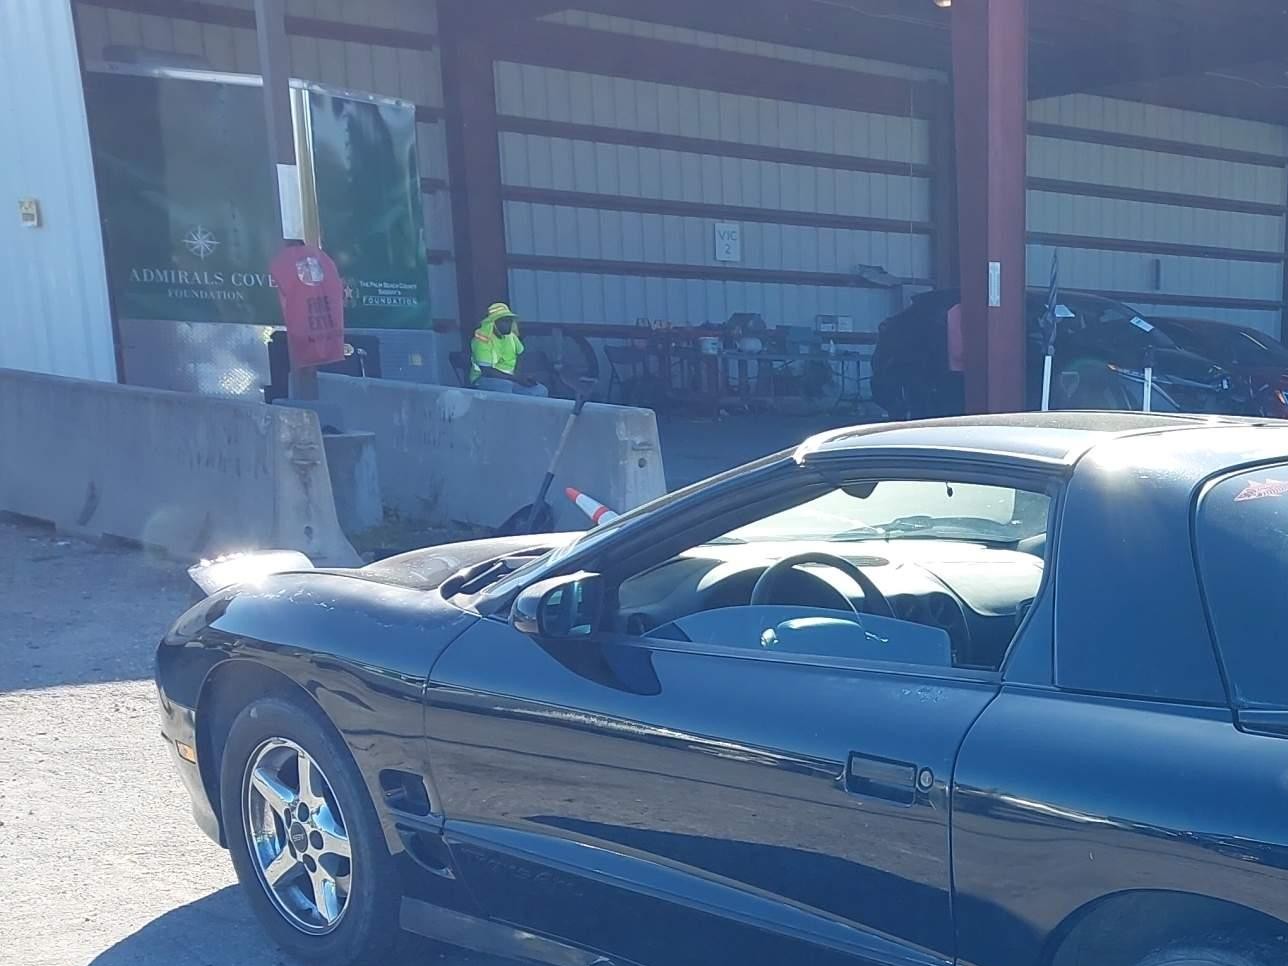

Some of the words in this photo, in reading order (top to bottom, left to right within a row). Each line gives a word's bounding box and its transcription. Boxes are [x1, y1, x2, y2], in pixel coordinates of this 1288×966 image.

[130, 267, 224, 286] ADMIRALS
[231, 272, 279, 288] COVE
[167, 287, 245, 301] FOUNDATION
[363, 295, 418, 305] FOUNDATION
